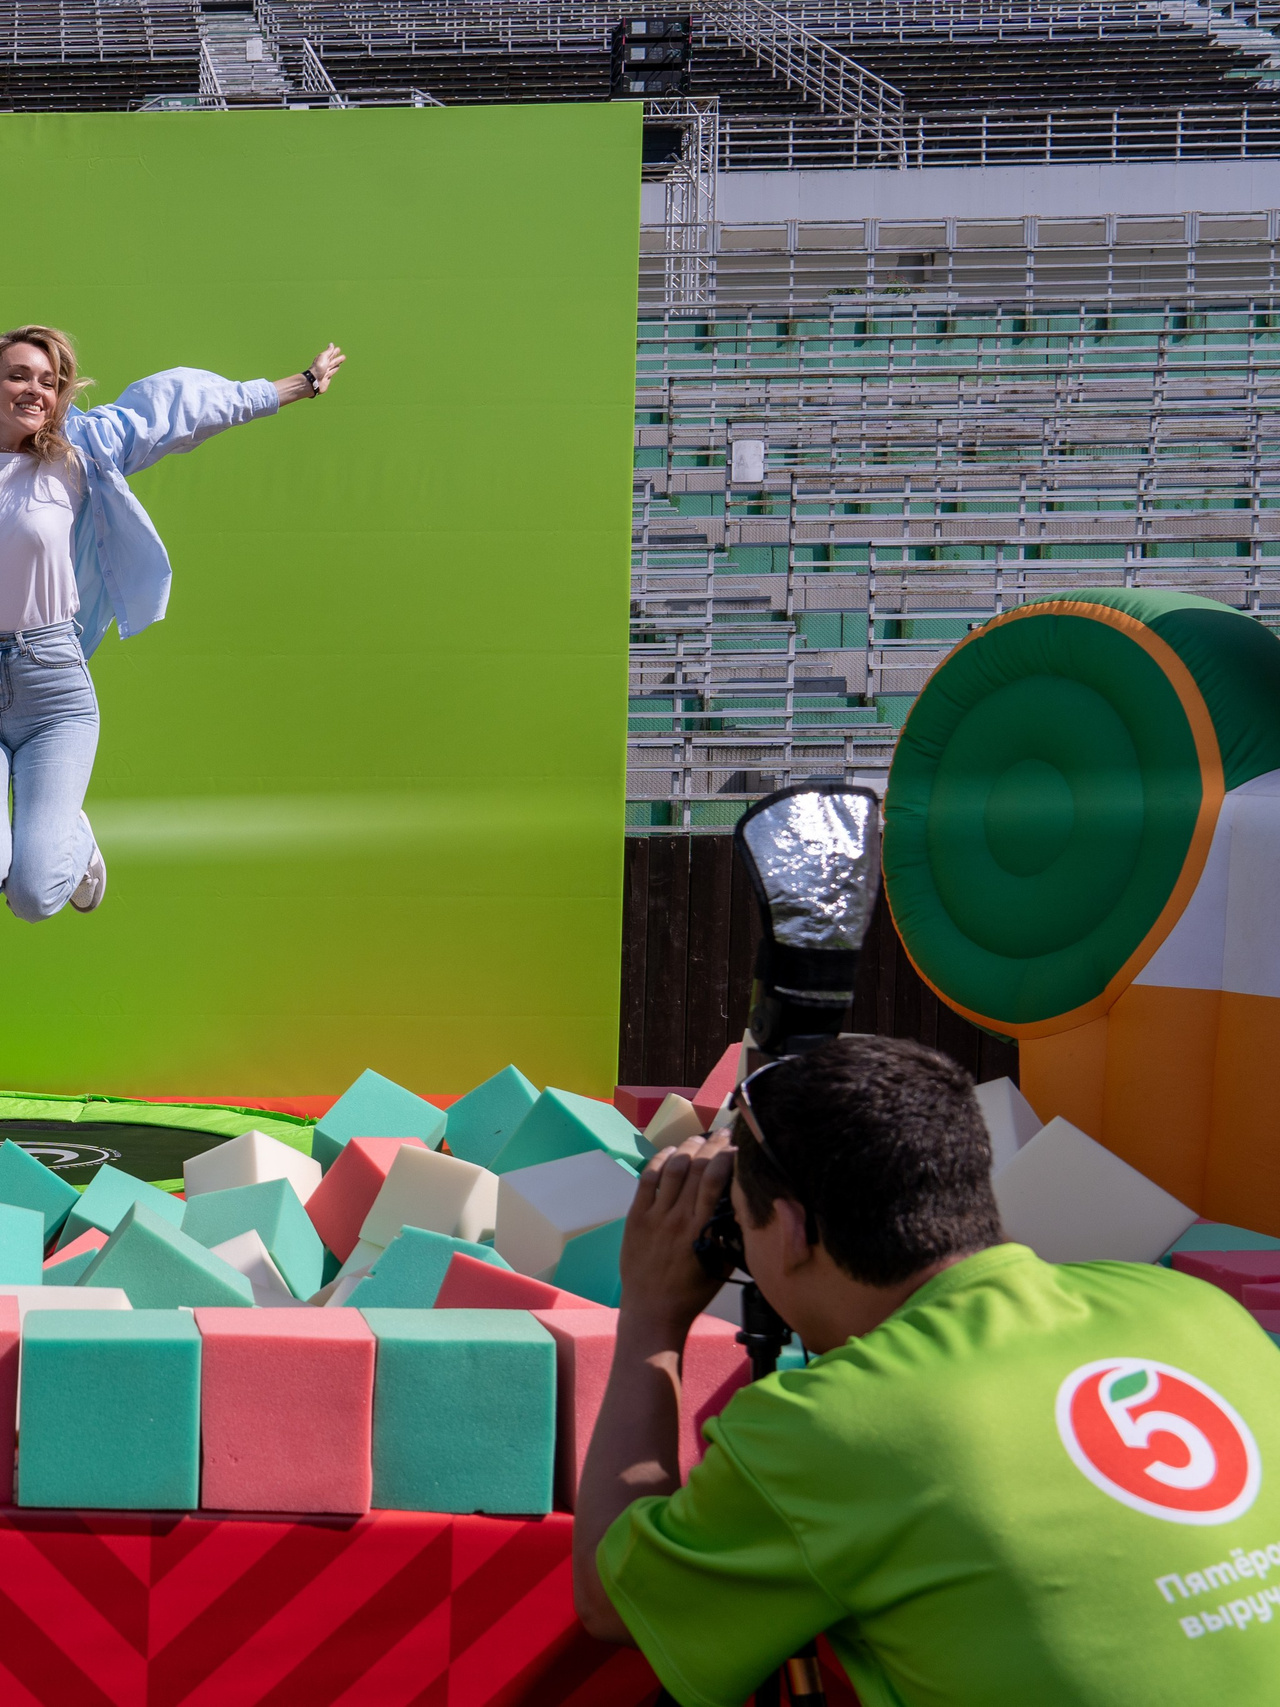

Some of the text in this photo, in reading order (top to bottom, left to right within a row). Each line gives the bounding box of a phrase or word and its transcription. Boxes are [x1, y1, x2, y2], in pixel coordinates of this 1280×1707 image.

[1098, 1366, 1217, 1491] 5
[1154, 1541, 1280, 1604] Пятёро
[1179, 1585, 1280, 1639] выруч
